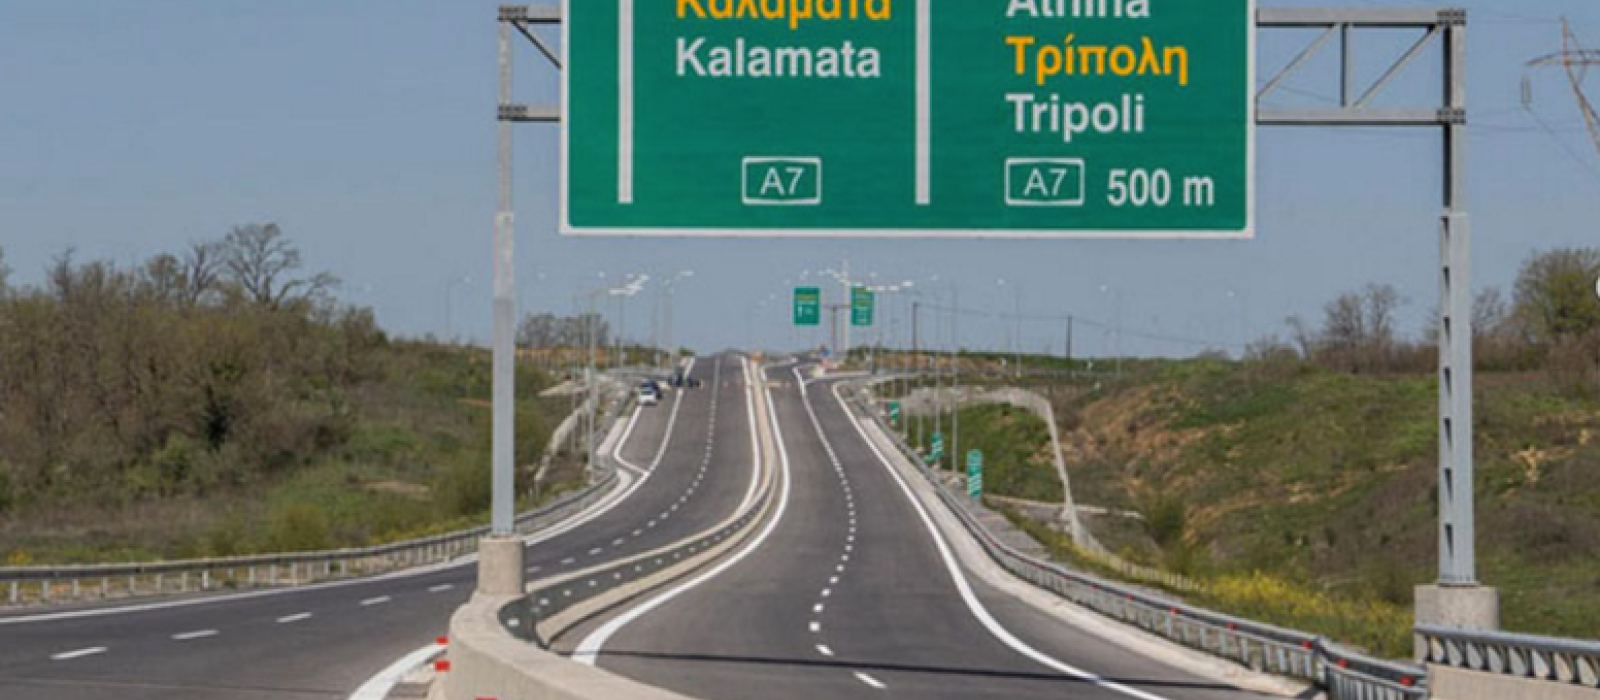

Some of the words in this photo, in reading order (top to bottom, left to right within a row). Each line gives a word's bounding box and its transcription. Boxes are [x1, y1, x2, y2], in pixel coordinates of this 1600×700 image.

[676, 37, 880, 77] Kalamata
[1006, 33, 1189, 86] Τρίπολη
[1006, 93, 1145, 142] Tripoli
[760, 167, 804, 195] A7
[1024, 168, 1068, 195] A7
[1108, 168, 1172, 206] 500
[1183, 176, 1215, 206] m
